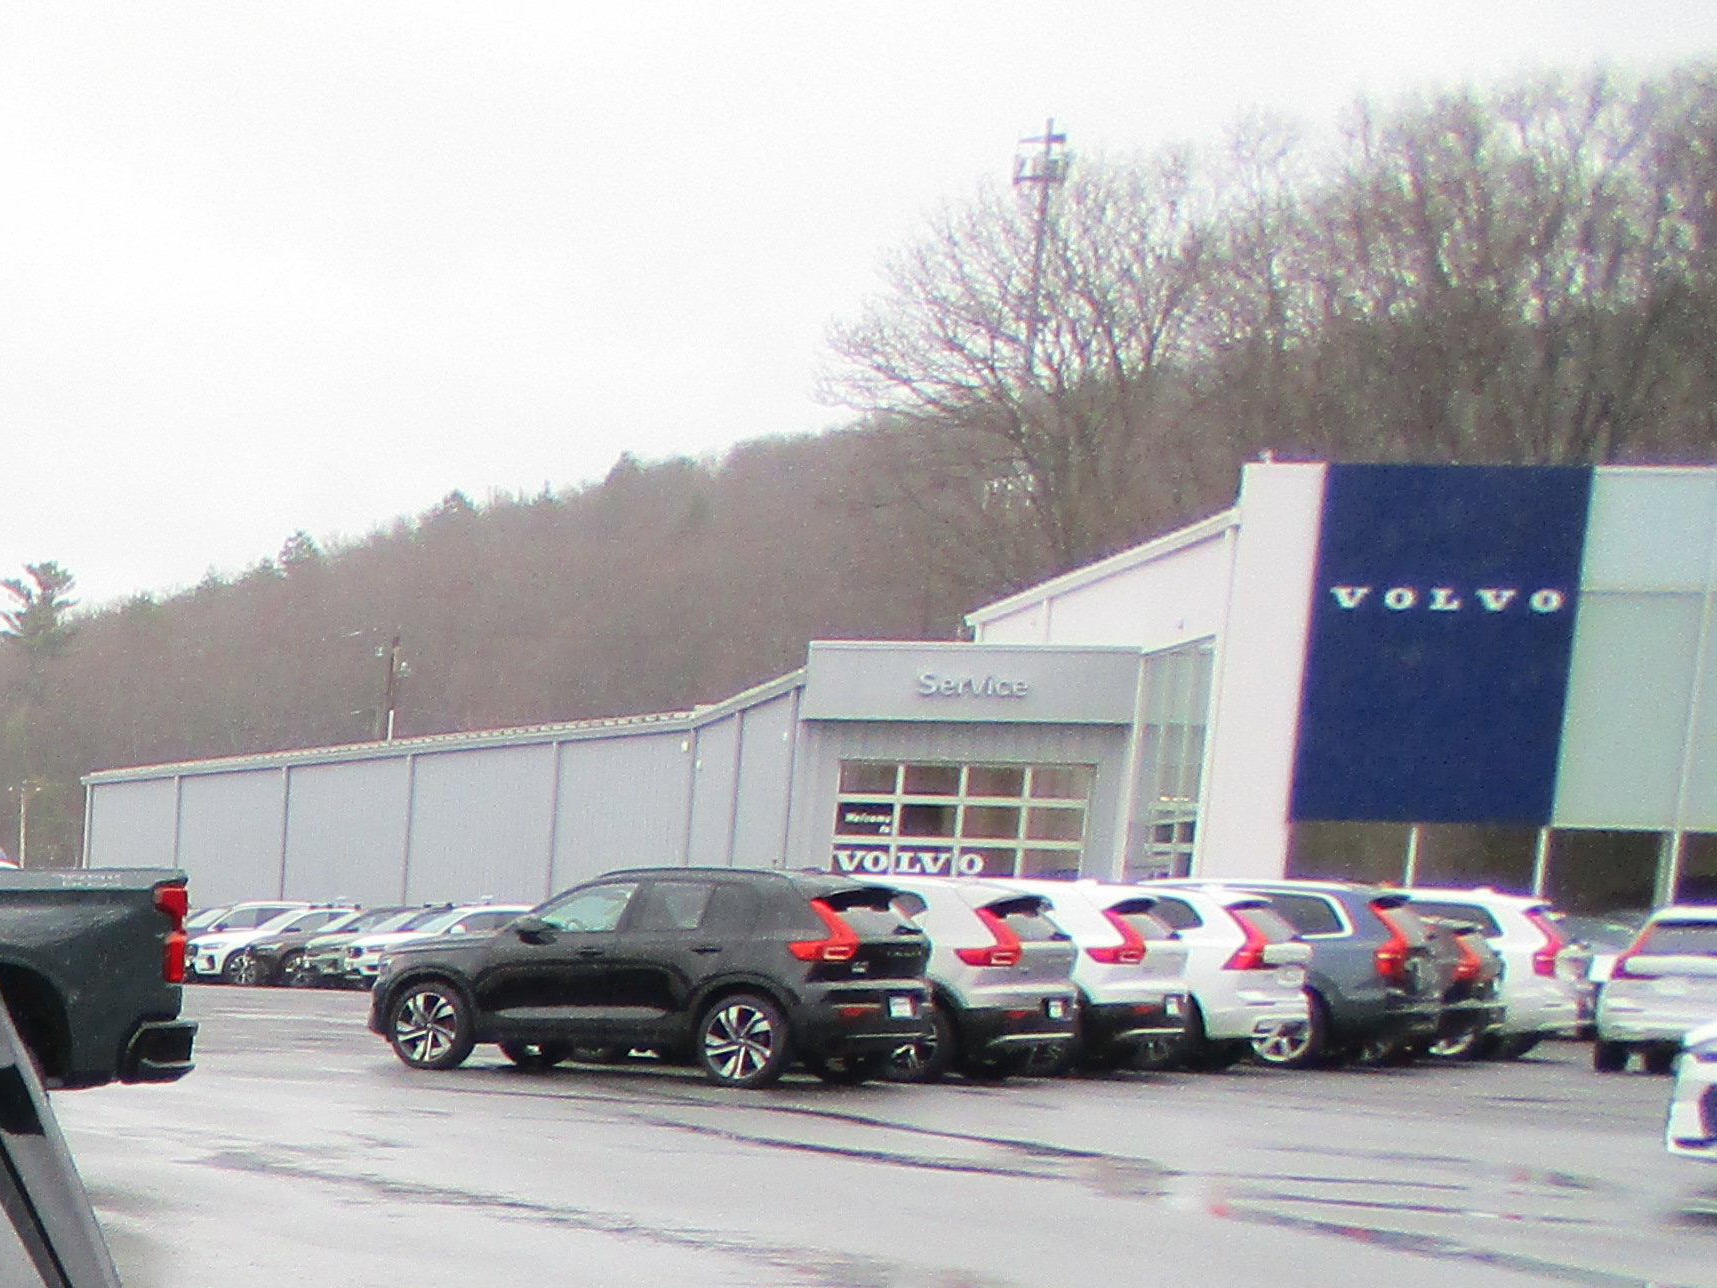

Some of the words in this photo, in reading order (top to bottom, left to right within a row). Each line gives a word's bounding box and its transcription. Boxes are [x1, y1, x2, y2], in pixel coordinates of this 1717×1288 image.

[1329, 585, 1565, 613] VOLVO
[917, 671, 1028, 698] Service
[836, 850, 985, 875] VOLVO
